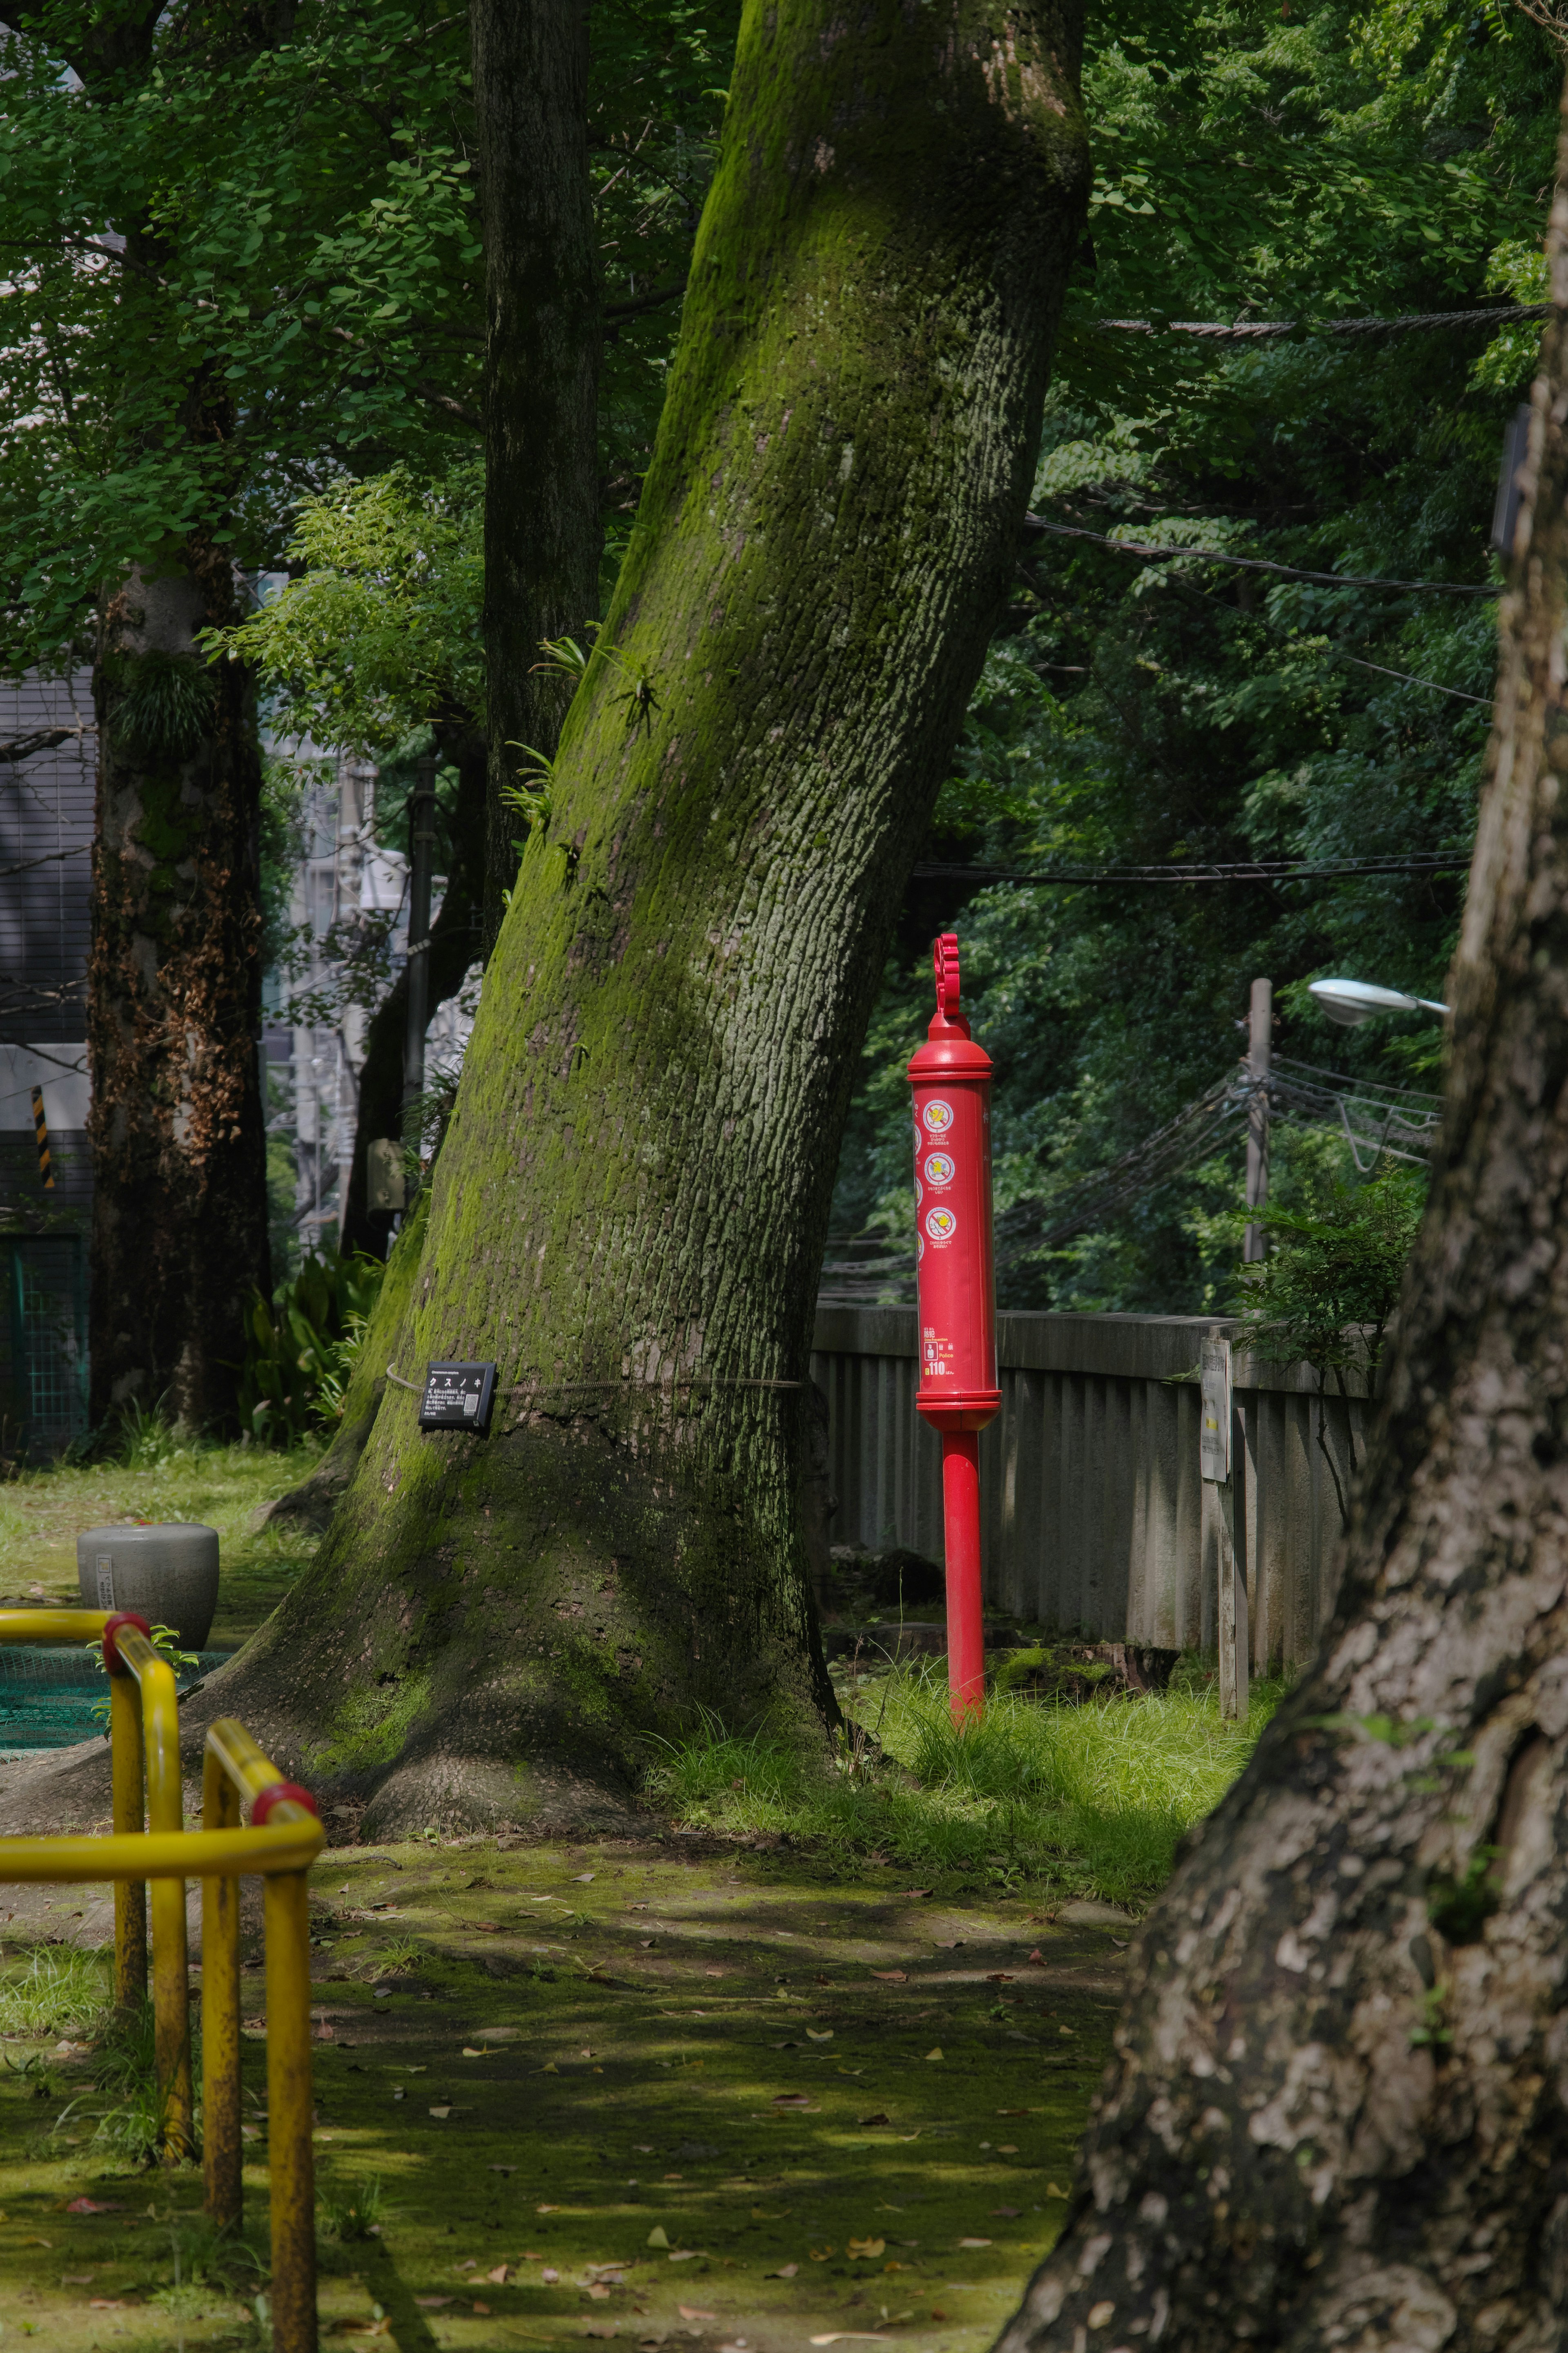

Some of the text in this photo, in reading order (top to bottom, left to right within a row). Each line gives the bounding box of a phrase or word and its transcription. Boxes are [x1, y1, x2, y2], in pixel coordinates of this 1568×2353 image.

[929, 1361, 945, 1375] 110
[430, 1377, 481, 1388] クスノキ
